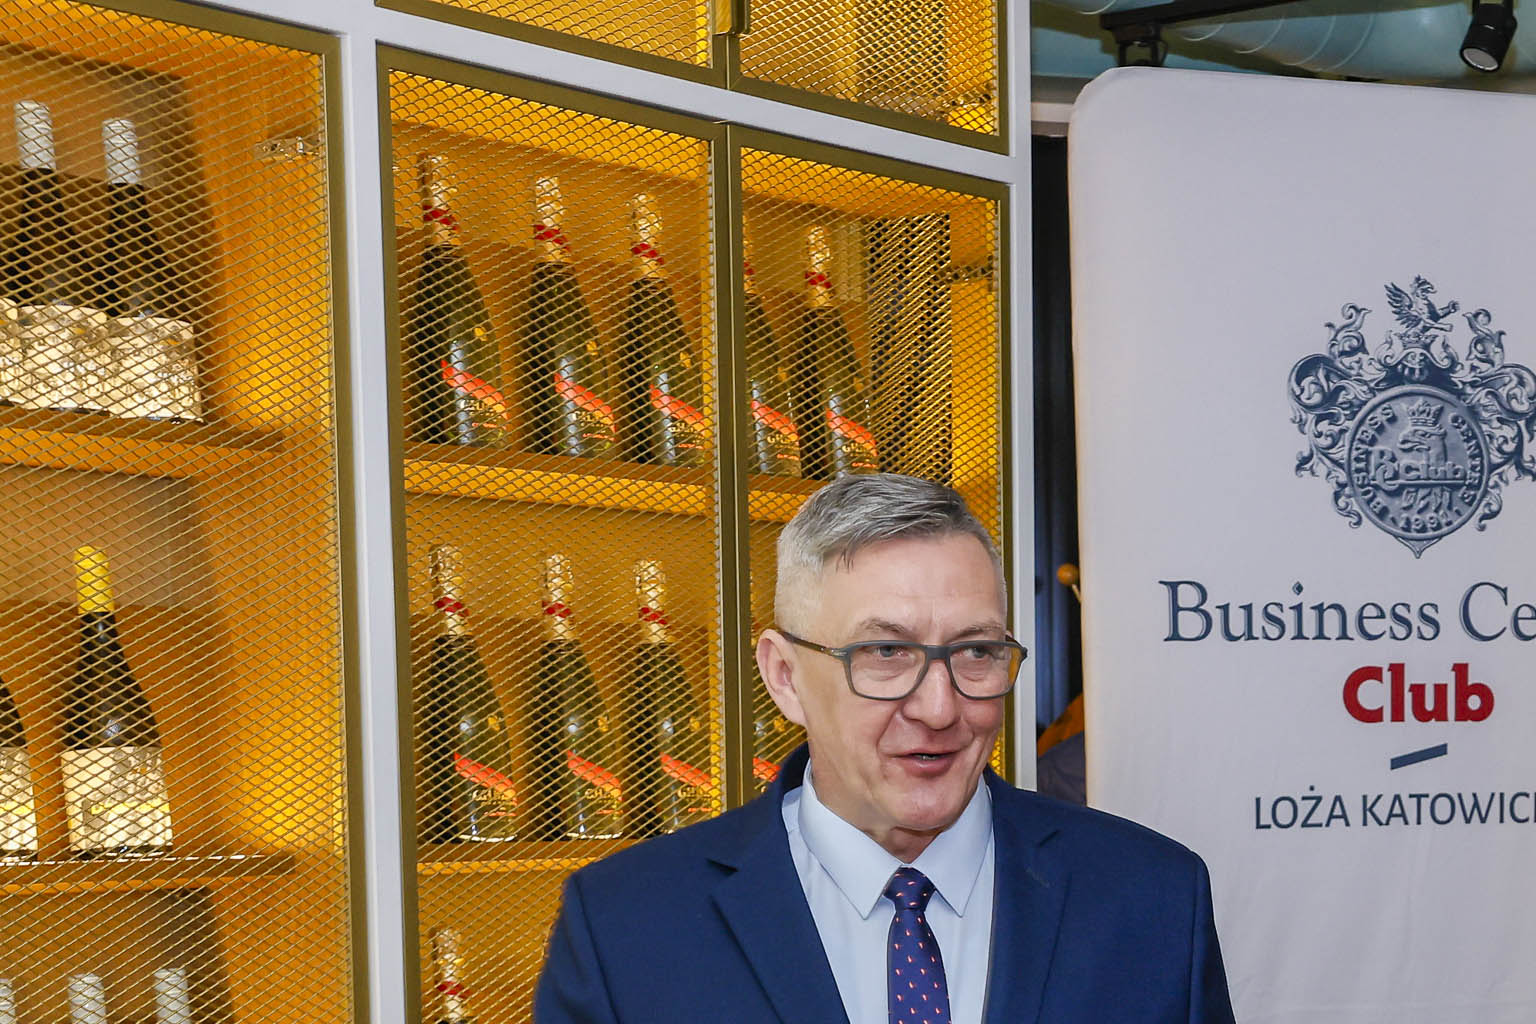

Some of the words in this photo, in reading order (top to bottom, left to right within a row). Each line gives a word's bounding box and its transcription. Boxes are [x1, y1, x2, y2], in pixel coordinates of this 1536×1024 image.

[1158, 580, 1441, 642] Business
[1343, 663, 1495, 723] Club
[1254, 785, 1350, 830] LOŻA
